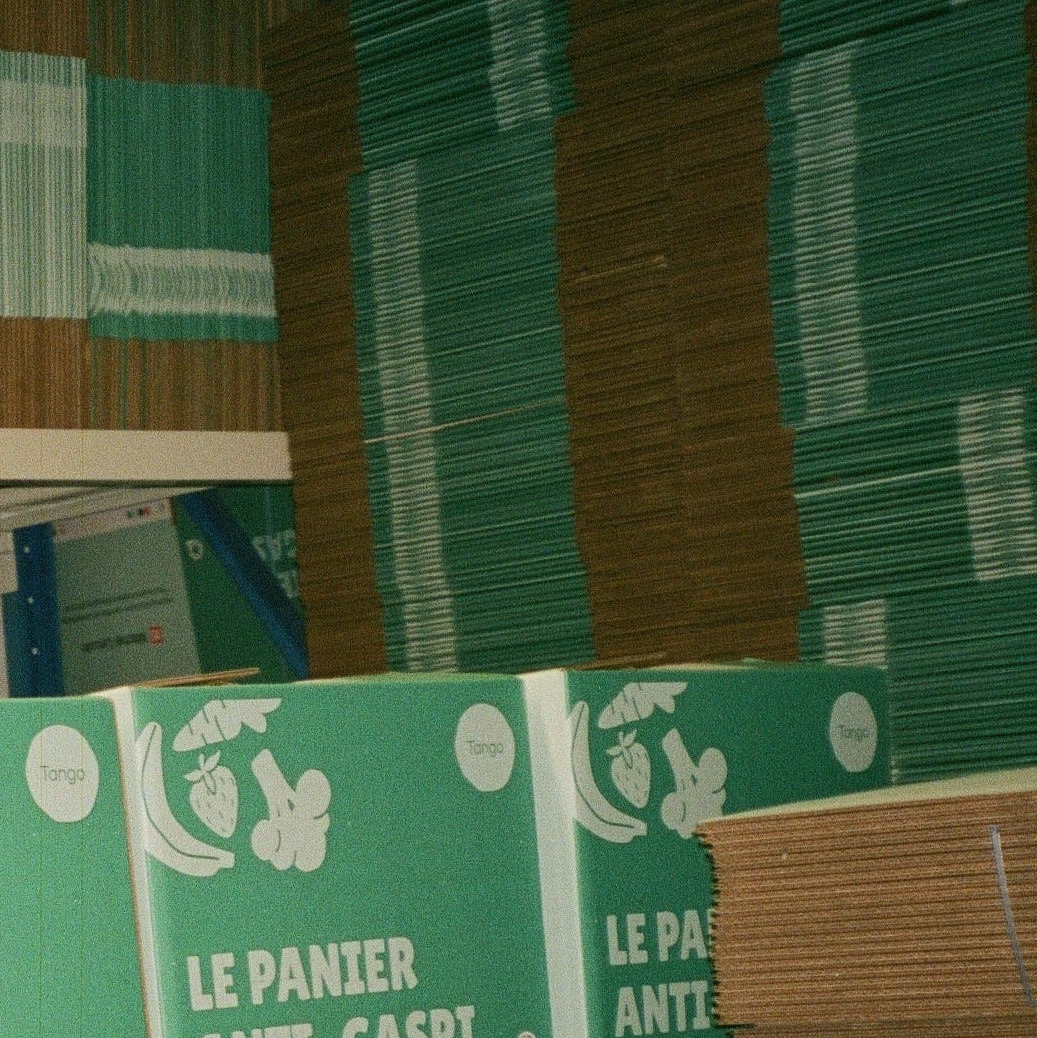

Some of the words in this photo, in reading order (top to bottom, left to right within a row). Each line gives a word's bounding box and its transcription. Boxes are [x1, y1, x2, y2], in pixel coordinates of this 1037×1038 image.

[466, 740, 504, 758] Tango
[40, 765, 86, 785] Tango
[606, 914, 649, 966] LE
[186, 952, 239, 1012] LE
[246, 936, 418, 1006] PANIER
